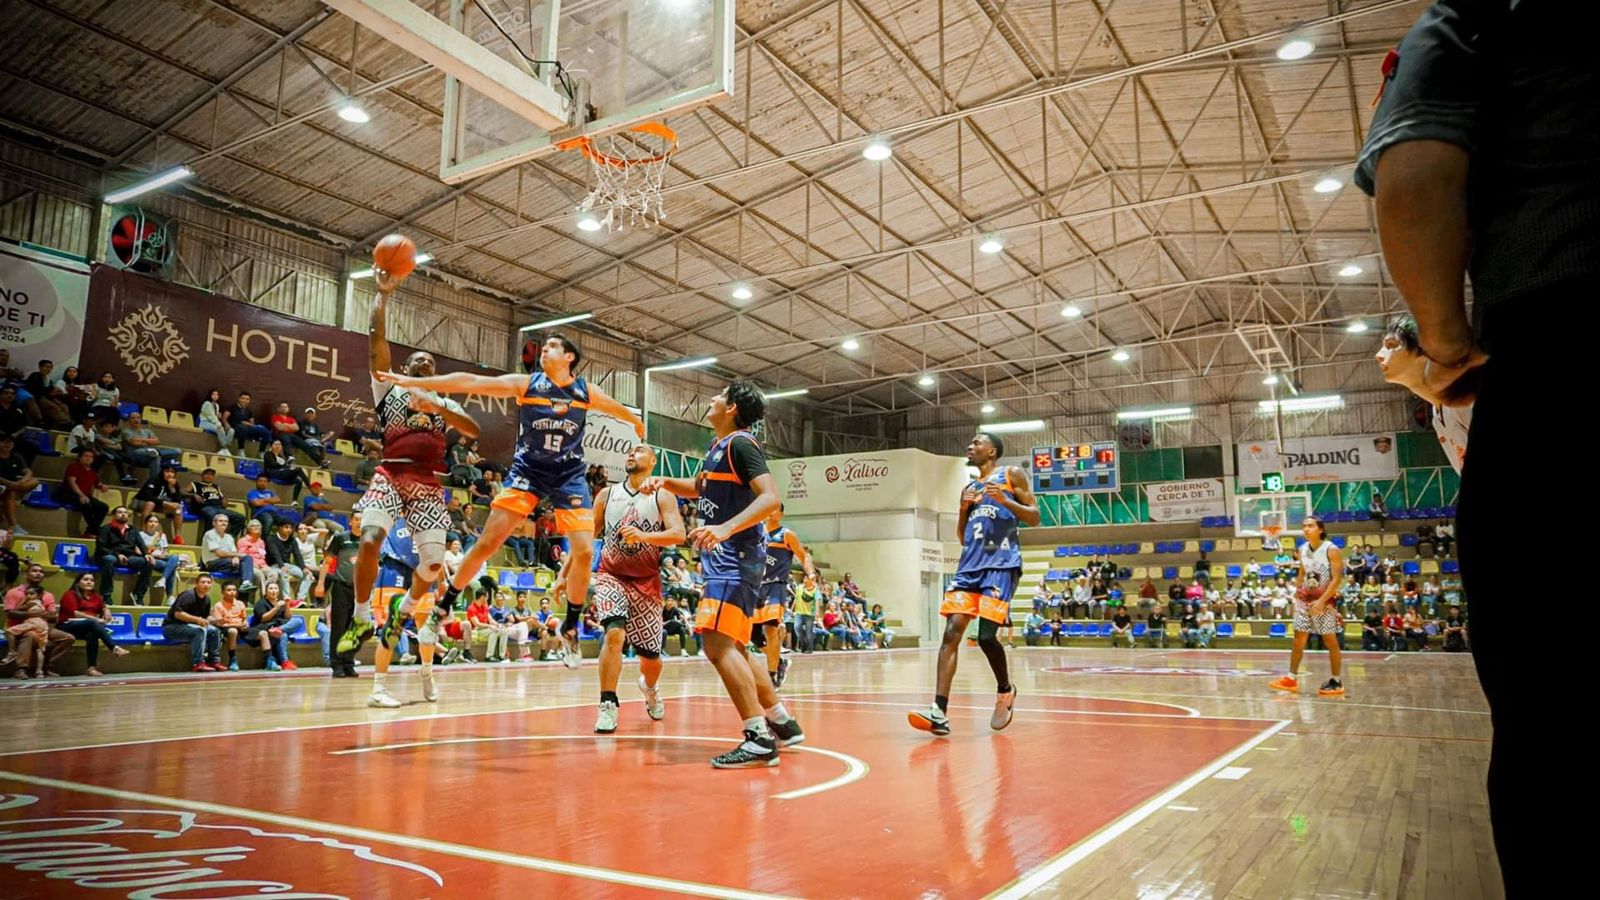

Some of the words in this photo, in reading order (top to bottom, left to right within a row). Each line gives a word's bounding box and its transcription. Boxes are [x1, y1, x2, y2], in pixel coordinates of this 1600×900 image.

[27, 311, 45, 327] TI
[1, 333, 26, 343] 2024
[206, 318, 350, 383] HOTEL
[315, 388, 377, 416] Boutique
[543, 433, 564, 453] 13
[583, 421, 633, 455] alisco
[1035, 454, 1052, 468] 25
[1101, 450, 1114, 464] 17
[1284, 447, 1361, 469] PALDING
[841, 462, 889, 482] Xalisco
[1160, 482, 1210, 493] GOBIERNO
[1157, 493, 1188, 501] CERCA
[973, 522, 984, 540] 2
